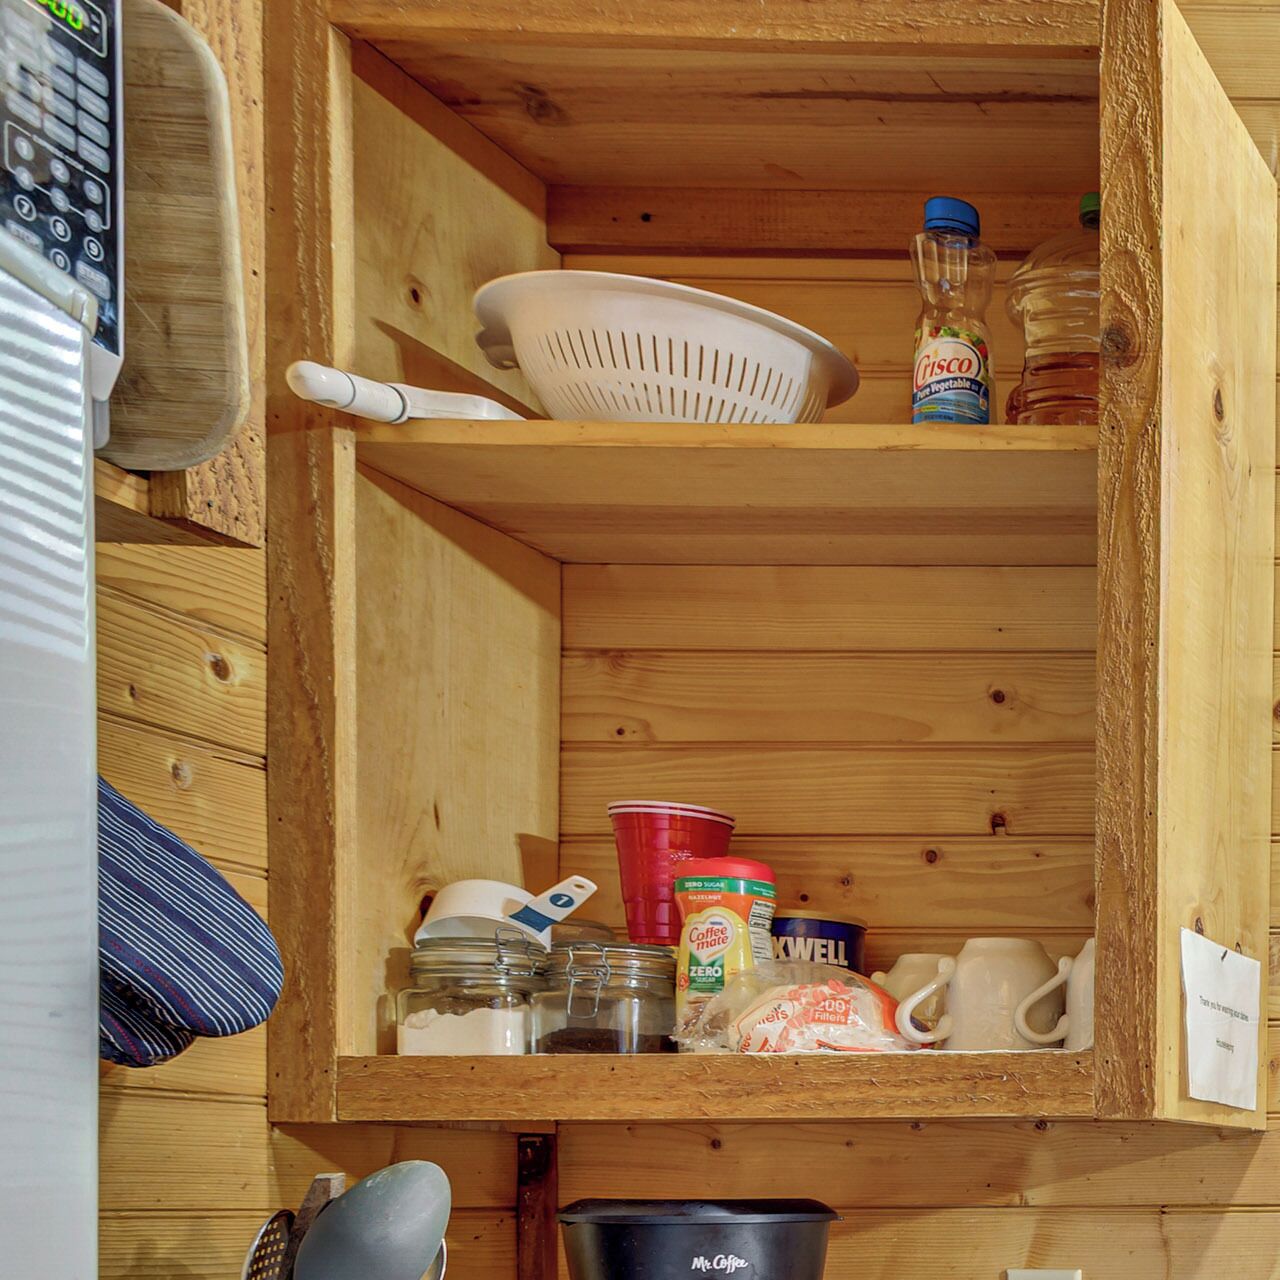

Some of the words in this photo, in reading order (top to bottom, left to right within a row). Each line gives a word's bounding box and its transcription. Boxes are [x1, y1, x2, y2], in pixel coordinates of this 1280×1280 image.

[914, 354, 973, 391] Crisco
[930, 379, 971, 394] Vegetable
[556, 895, 570, 906] 1
[689, 926, 728, 943] Coffee
[696, 935, 729, 952] mate
[689, 966, 722, 977] ZERO
[814, 1010, 846, 1023] Filters
[712, 1254, 749, 1274] Coffee
